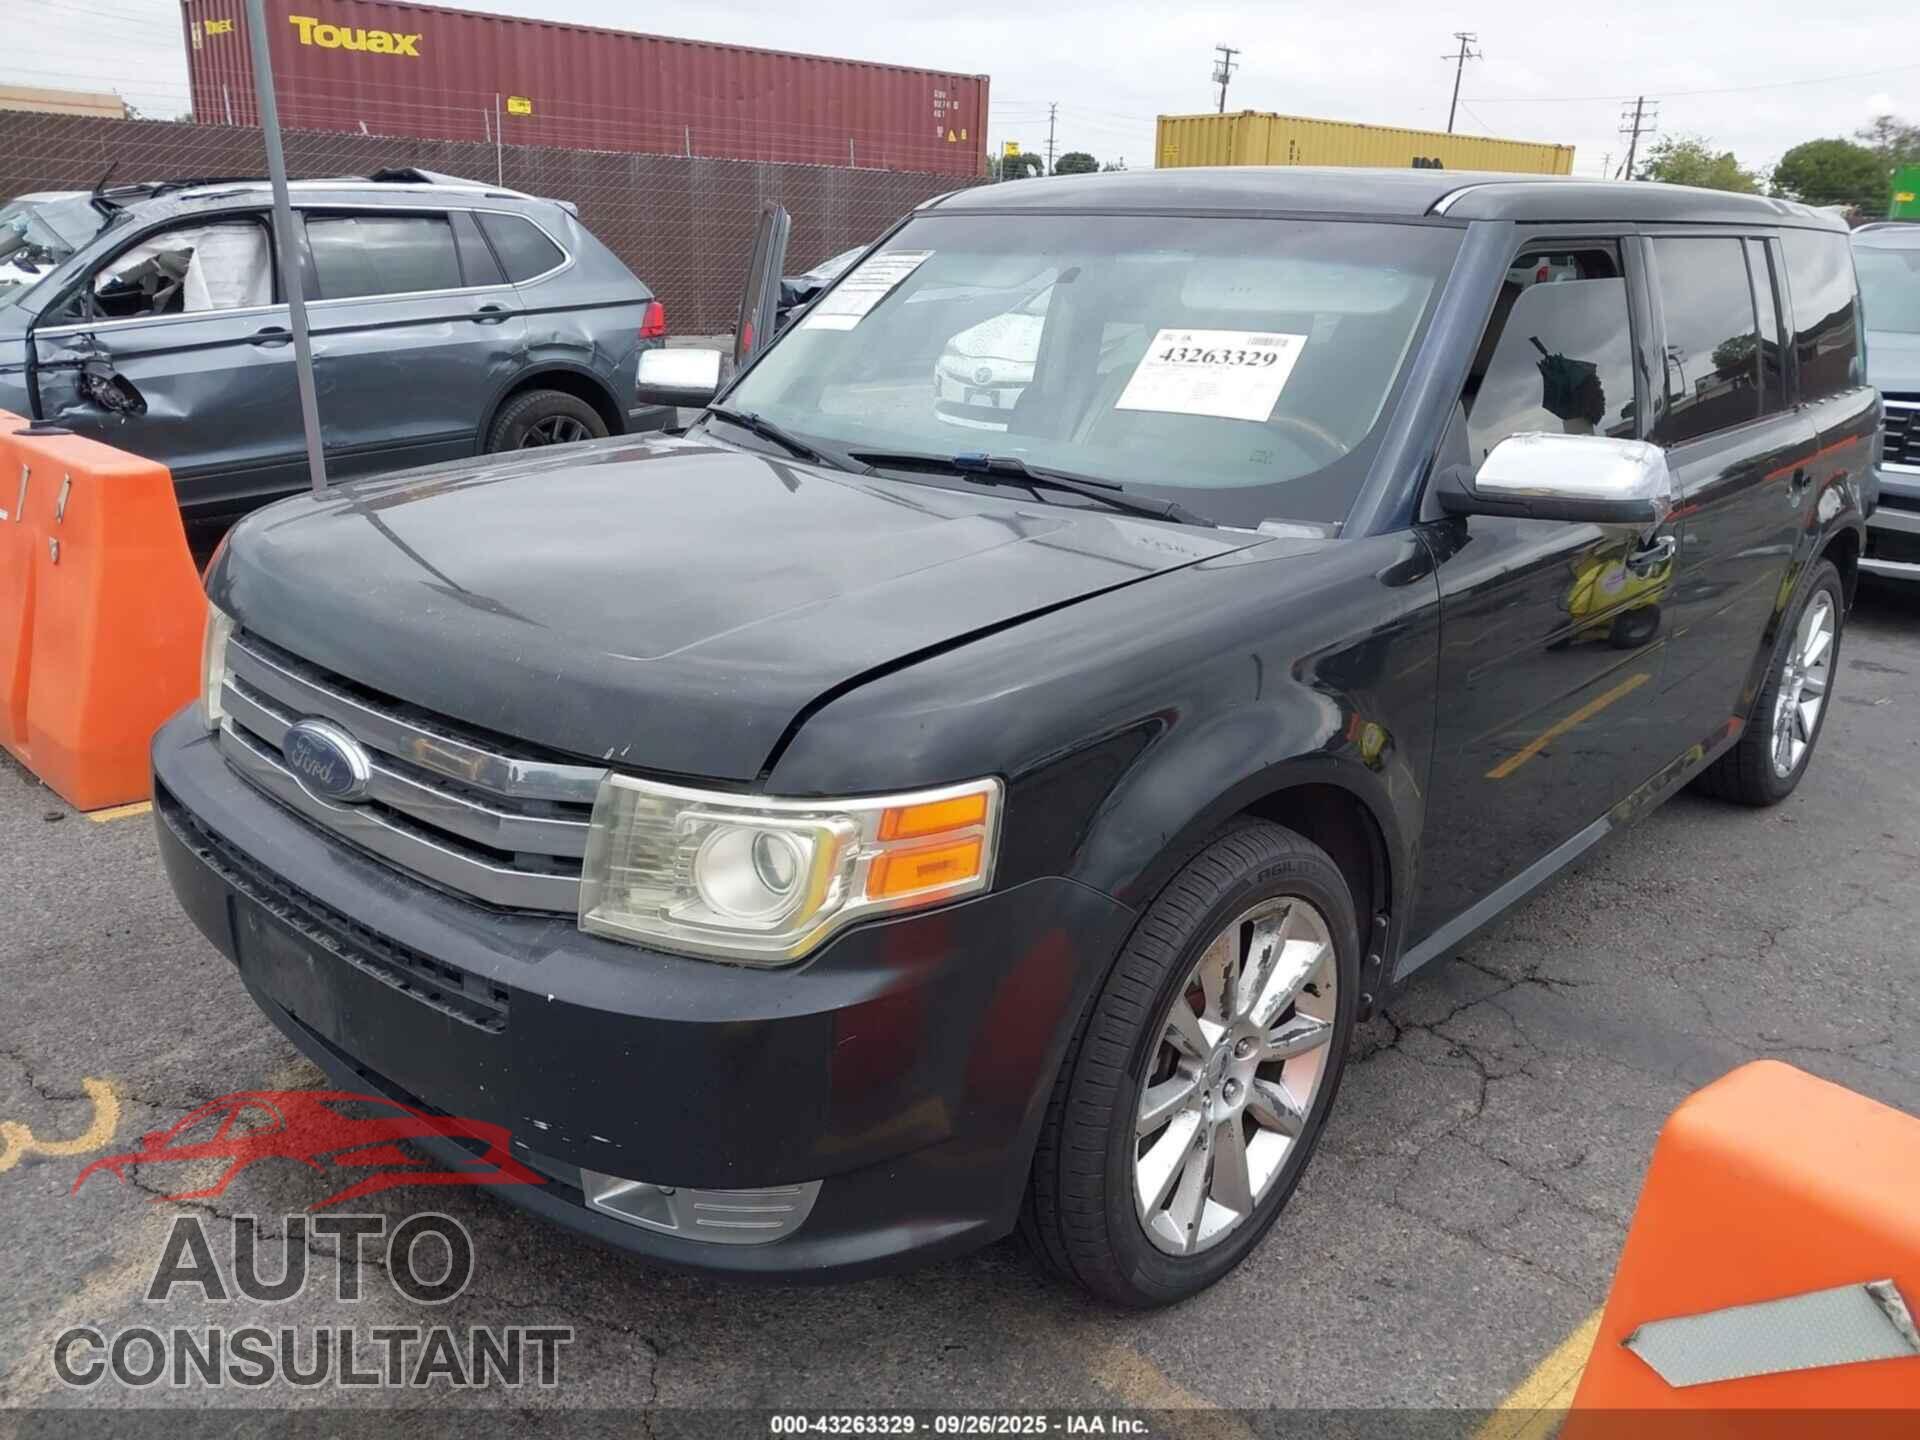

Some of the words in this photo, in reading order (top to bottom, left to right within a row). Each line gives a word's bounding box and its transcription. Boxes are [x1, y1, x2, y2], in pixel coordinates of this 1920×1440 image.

[289, 15, 420, 56] Touax
[1159, 347, 1278, 367] 43263329
[292, 734, 336, 784] Ford
